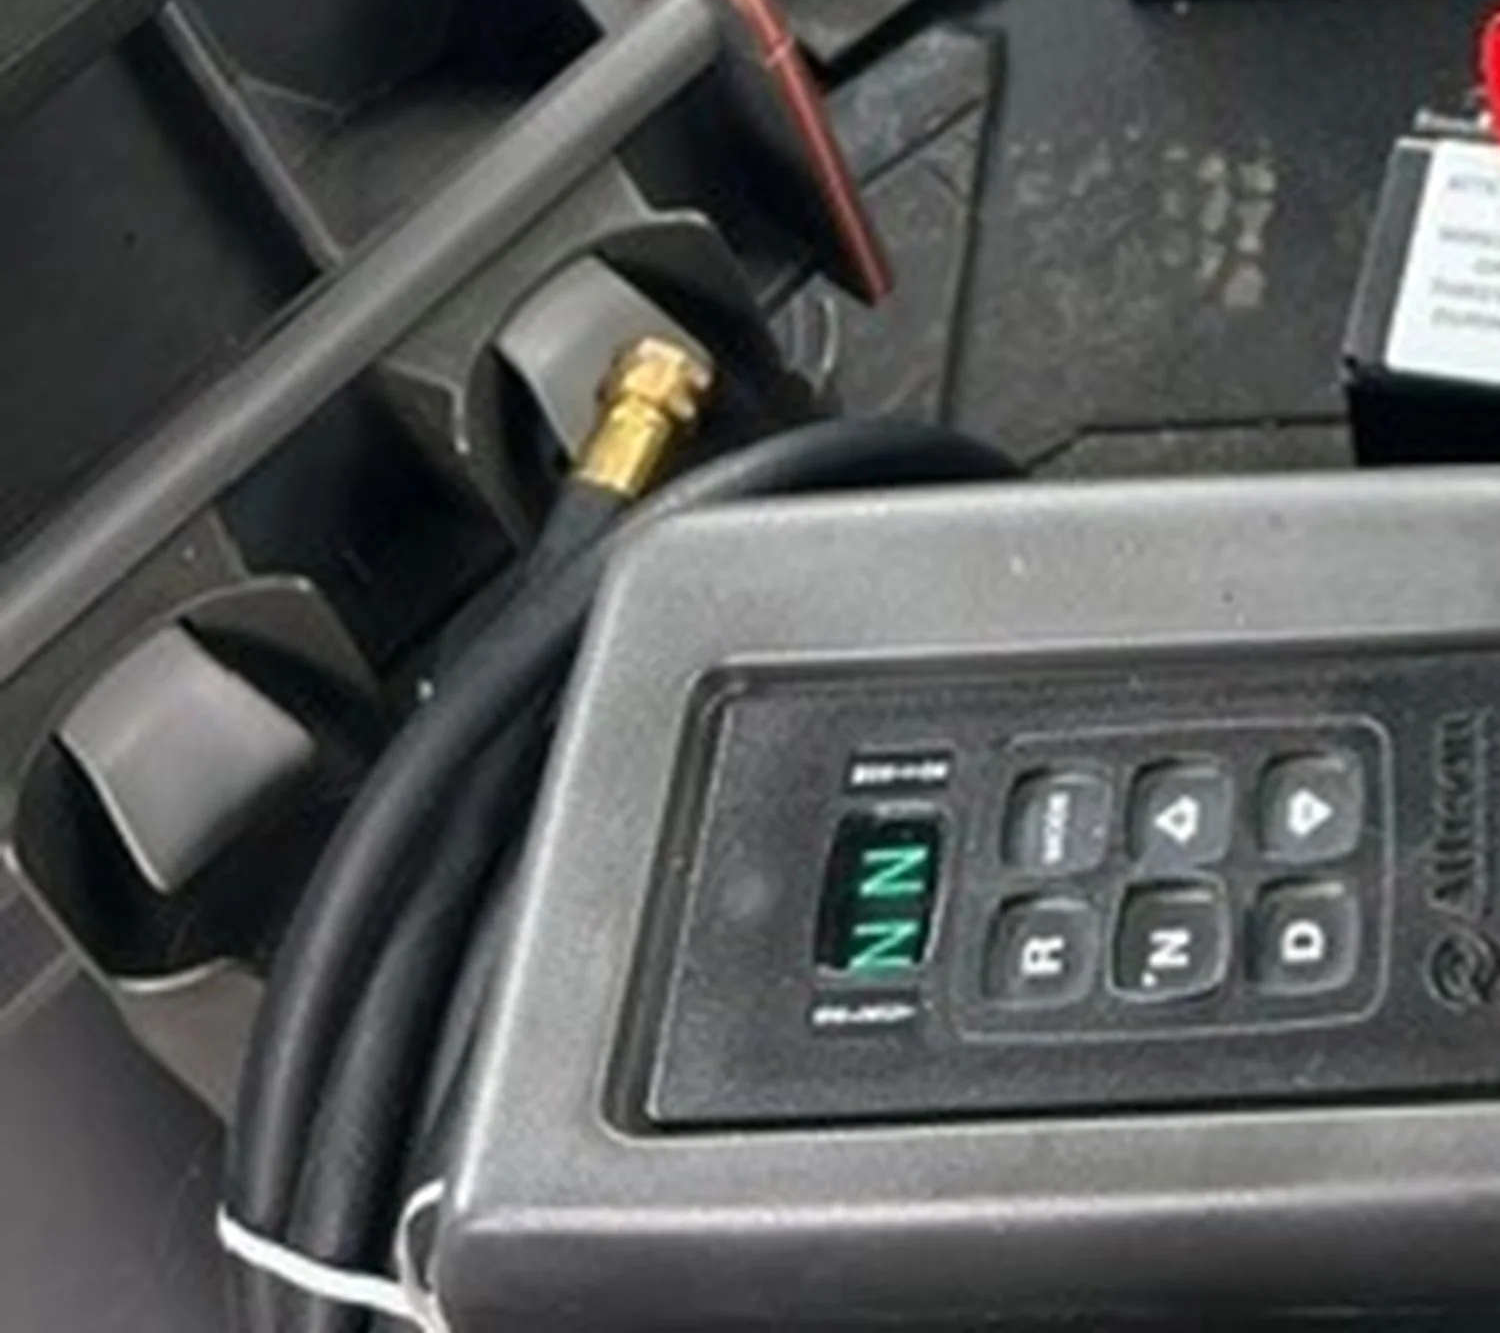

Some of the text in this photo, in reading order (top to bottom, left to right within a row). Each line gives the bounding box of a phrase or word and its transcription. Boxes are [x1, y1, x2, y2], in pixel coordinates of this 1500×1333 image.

[1021, 936, 1065, 976] R
[1147, 927, 1192, 969] N
[1280, 918, 1326, 963] D
